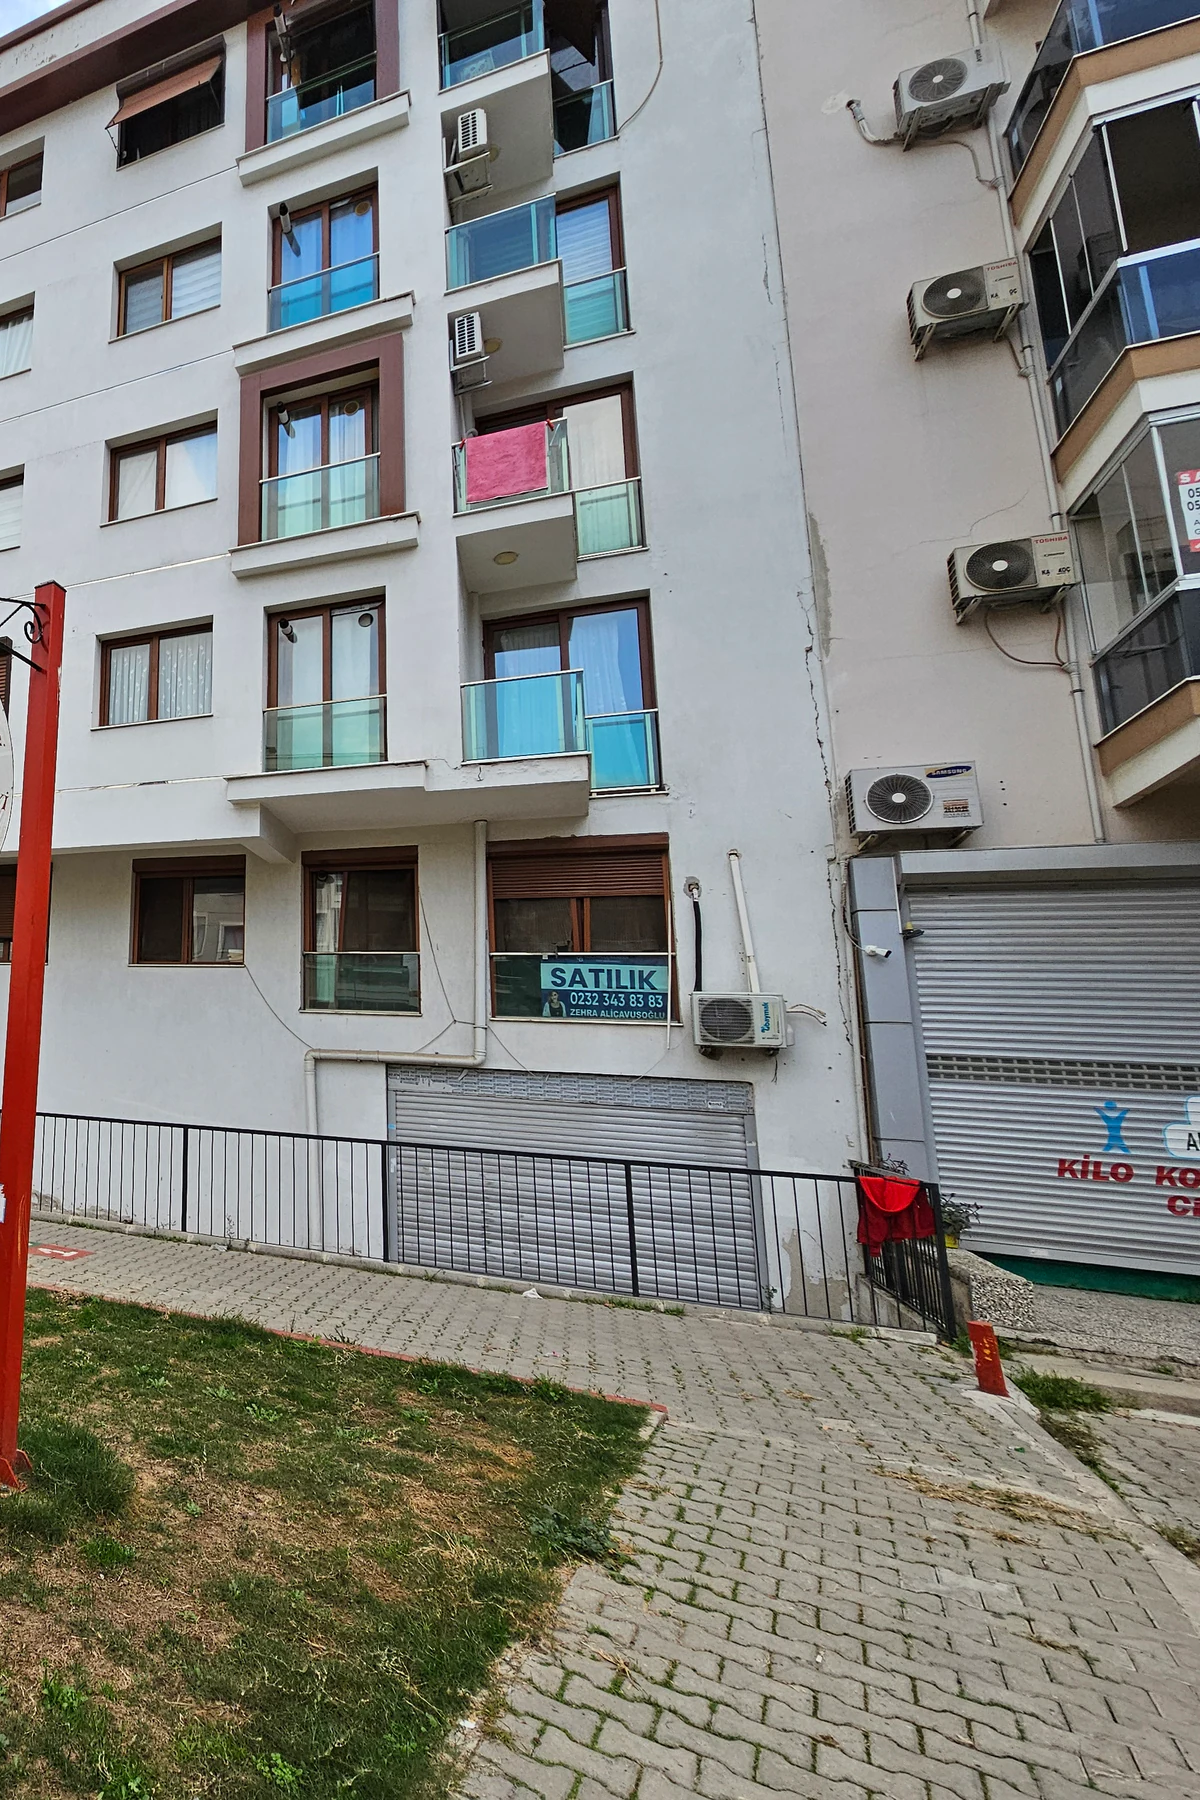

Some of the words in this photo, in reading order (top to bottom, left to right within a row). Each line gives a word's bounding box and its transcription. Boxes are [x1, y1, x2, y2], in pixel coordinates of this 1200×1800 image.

[1034, 536, 1068, 544] TOSHIBA
[551, 967, 658, 991] SATILIK
[570, 992, 599, 1006] 0232
[603, 993, 626, 1007] 343
[629, 994, 644, 1008] 83
[648, 995, 663, 1008] 83
[570, 1008, 598, 1017] ZEHRA
[1057, 1154, 1135, 1183] KİLO
